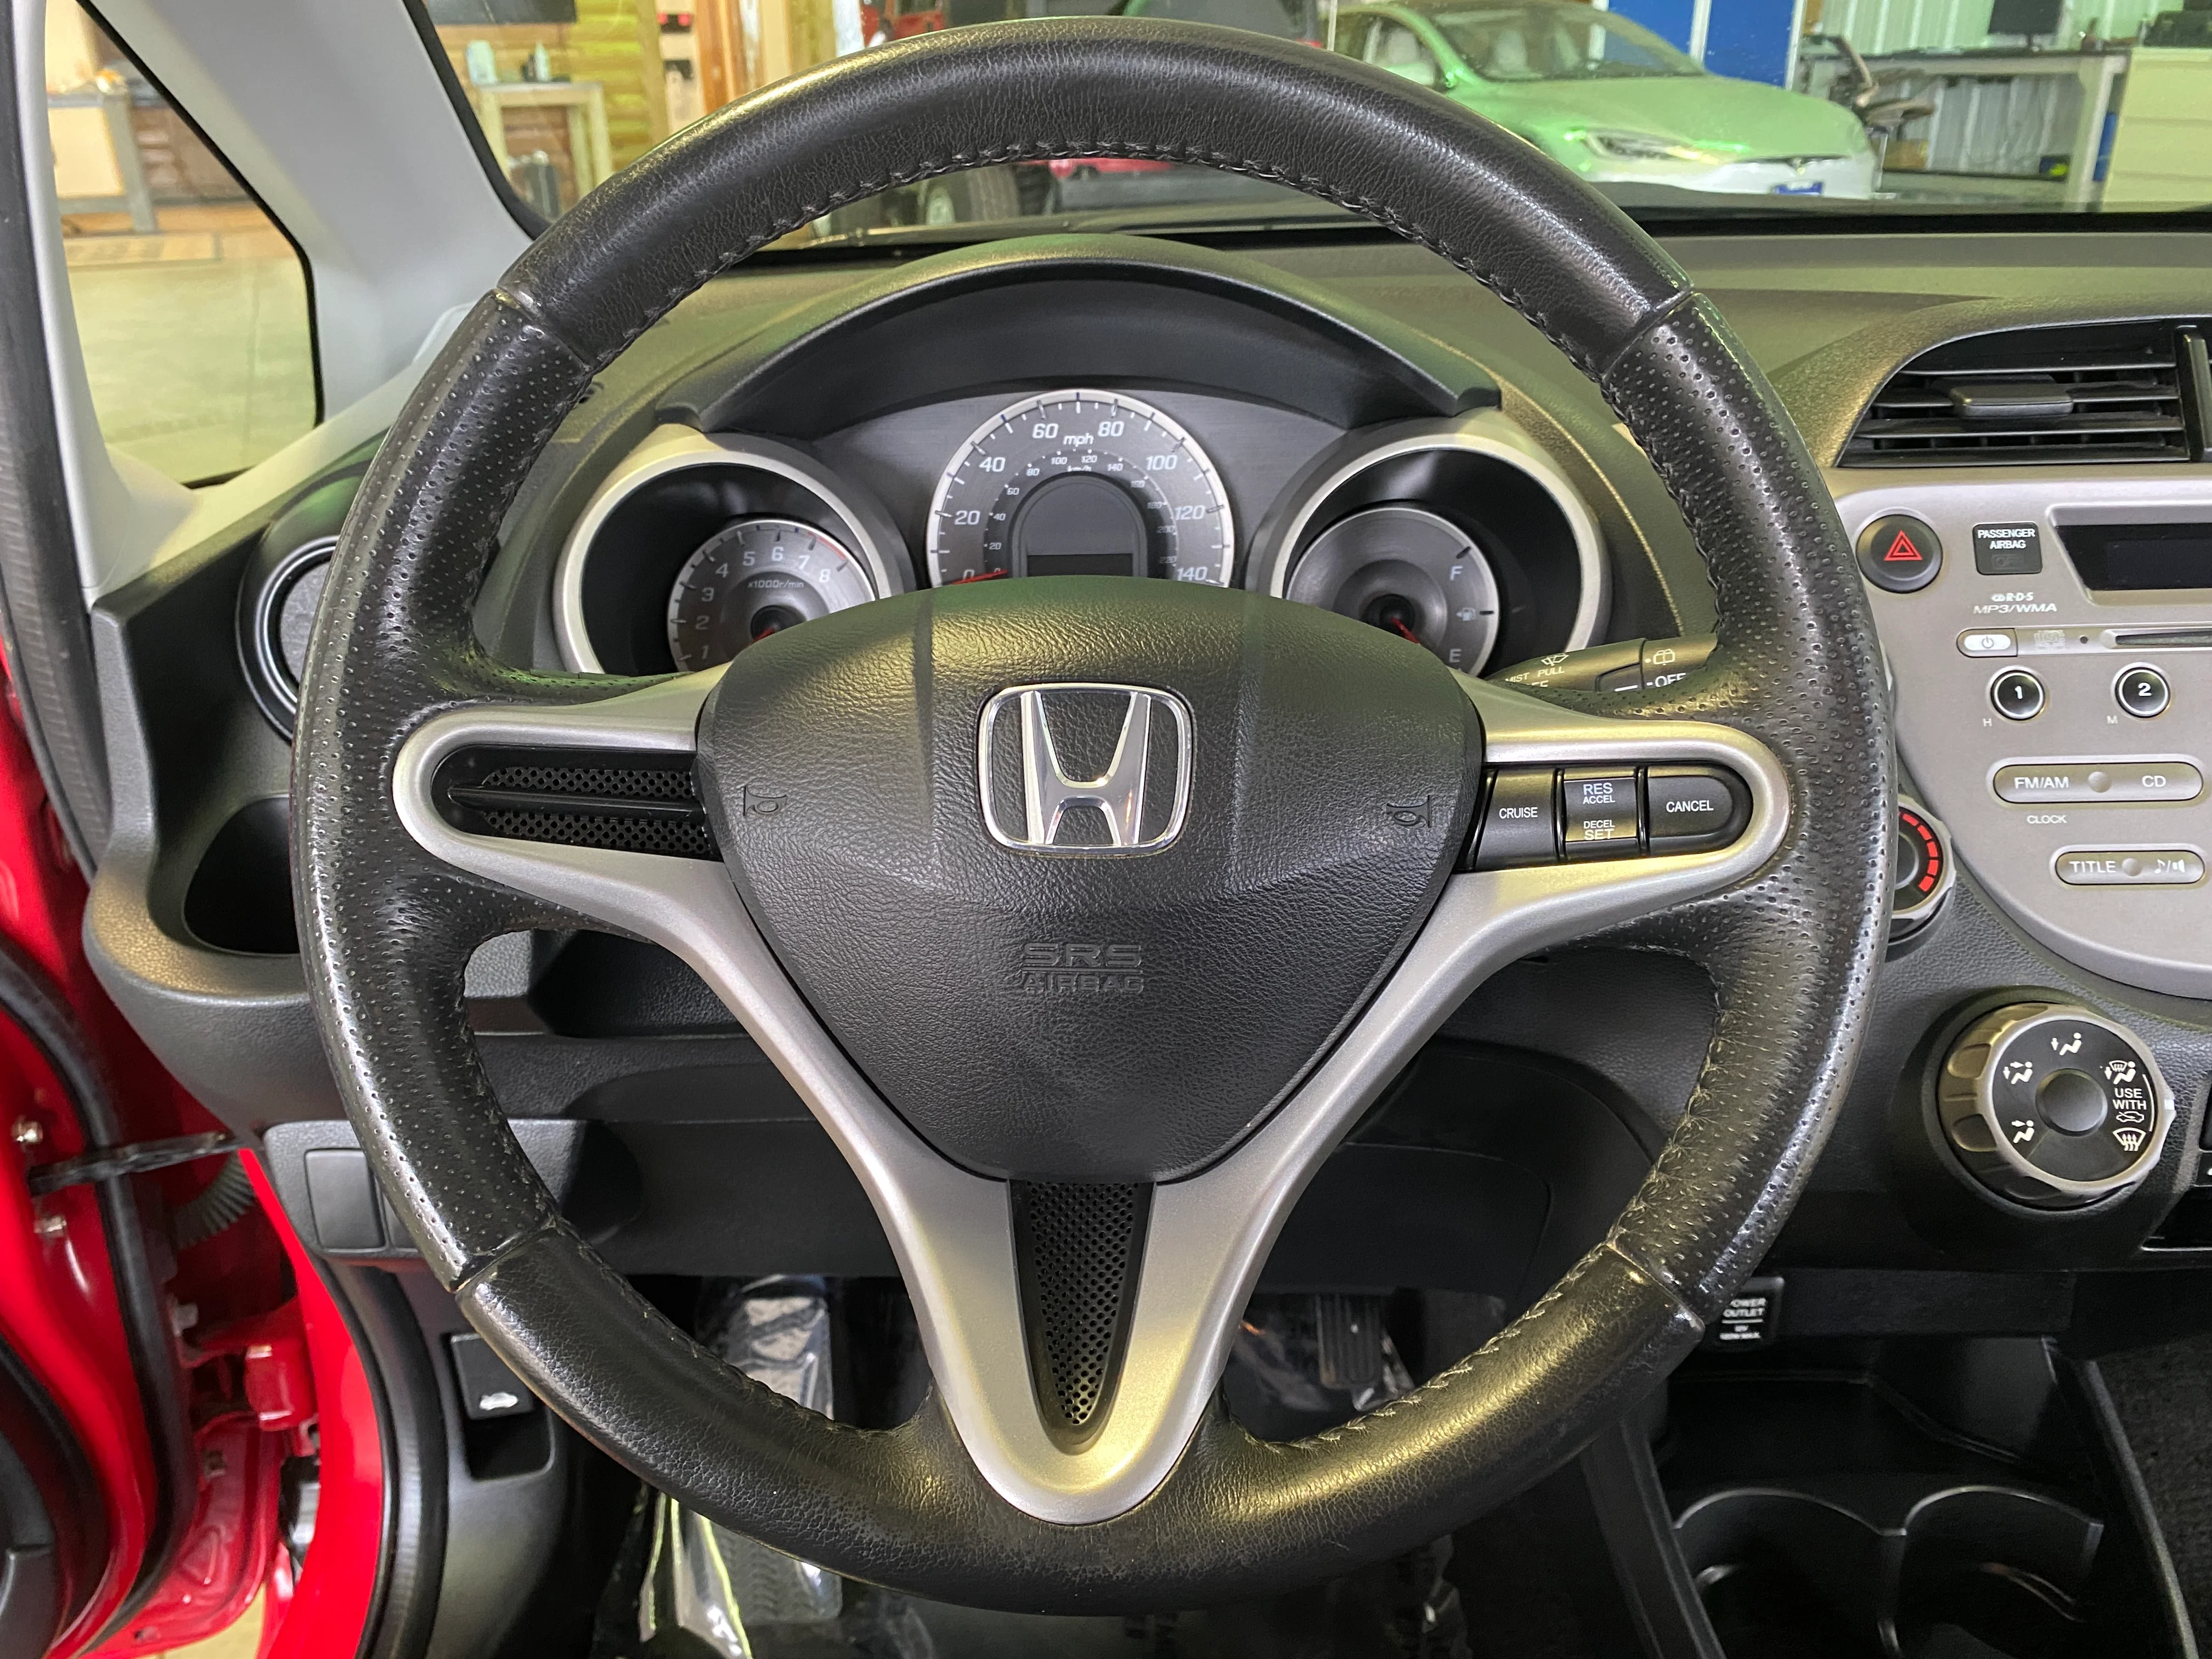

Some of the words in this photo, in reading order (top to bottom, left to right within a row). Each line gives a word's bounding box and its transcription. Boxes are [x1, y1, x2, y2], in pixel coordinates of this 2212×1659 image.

[1032, 423, 1058, 439] 60
[1098, 421, 1124, 437] 80
[1063, 432, 1094, 447] mph
[979, 457, 1006, 472] 40
[1051, 456, 1068, 465] 100
[1081, 455, 1098, 464] 120
[1146, 455, 1178, 471] 100
[1026, 468, 1040, 476] 80
[1107, 462, 1124, 471] 140
[1007, 487, 1020, 495] 60
[954, 510, 980, 525] 20
[1175, 505, 1206, 521] 120
[1978, 528, 2035, 539] PASSENGER
[989, 542, 1002, 550] 20
[1990, 540, 2026, 549] AIRBAG
[742, 551, 755, 566] 5
[771, 546, 784, 561] 6
[797, 555, 811, 570] 7
[715, 563, 729, 578] 4
[819, 568, 831, 583] 8
[1177, 566, 1208, 581] 140
[1450, 566, 1463, 580] F
[702, 588, 714, 602] 3
[1973, 603, 2057, 614] MP3/WMA
[695, 615, 709, 630] 2
[702, 645, 709, 659] 1
[1449, 648, 1462, 663] E
[1538, 667, 1565, 677] PULL
[2015, 685, 2023, 700] 1
[2138, 682, 2151, 697] 2
[1983, 718, 1993, 727] H
[2107, 715, 2118, 724] M
[2014, 776, 2069, 789] FM/AM
[2142, 775, 2166, 787] CD
[1583, 782, 1613, 795] RES
[1583, 795, 1616, 804] ACCEL
[1666, 800, 1714, 812] CANCEL
[1499, 807, 1538, 819] CRUISE
[2027, 815, 2067, 824] CLOCK
[1583, 820, 1615, 830] DECEL
[1584, 828, 1614, 840] SET
[2069, 861, 2116, 873] TITLE
[1024, 943, 1142, 966] SRS
[1023, 973, 1144, 992] AIRBAG
[2114, 1088, 2143, 1098] USE
[2113, 1099, 2147, 1110] WITH
